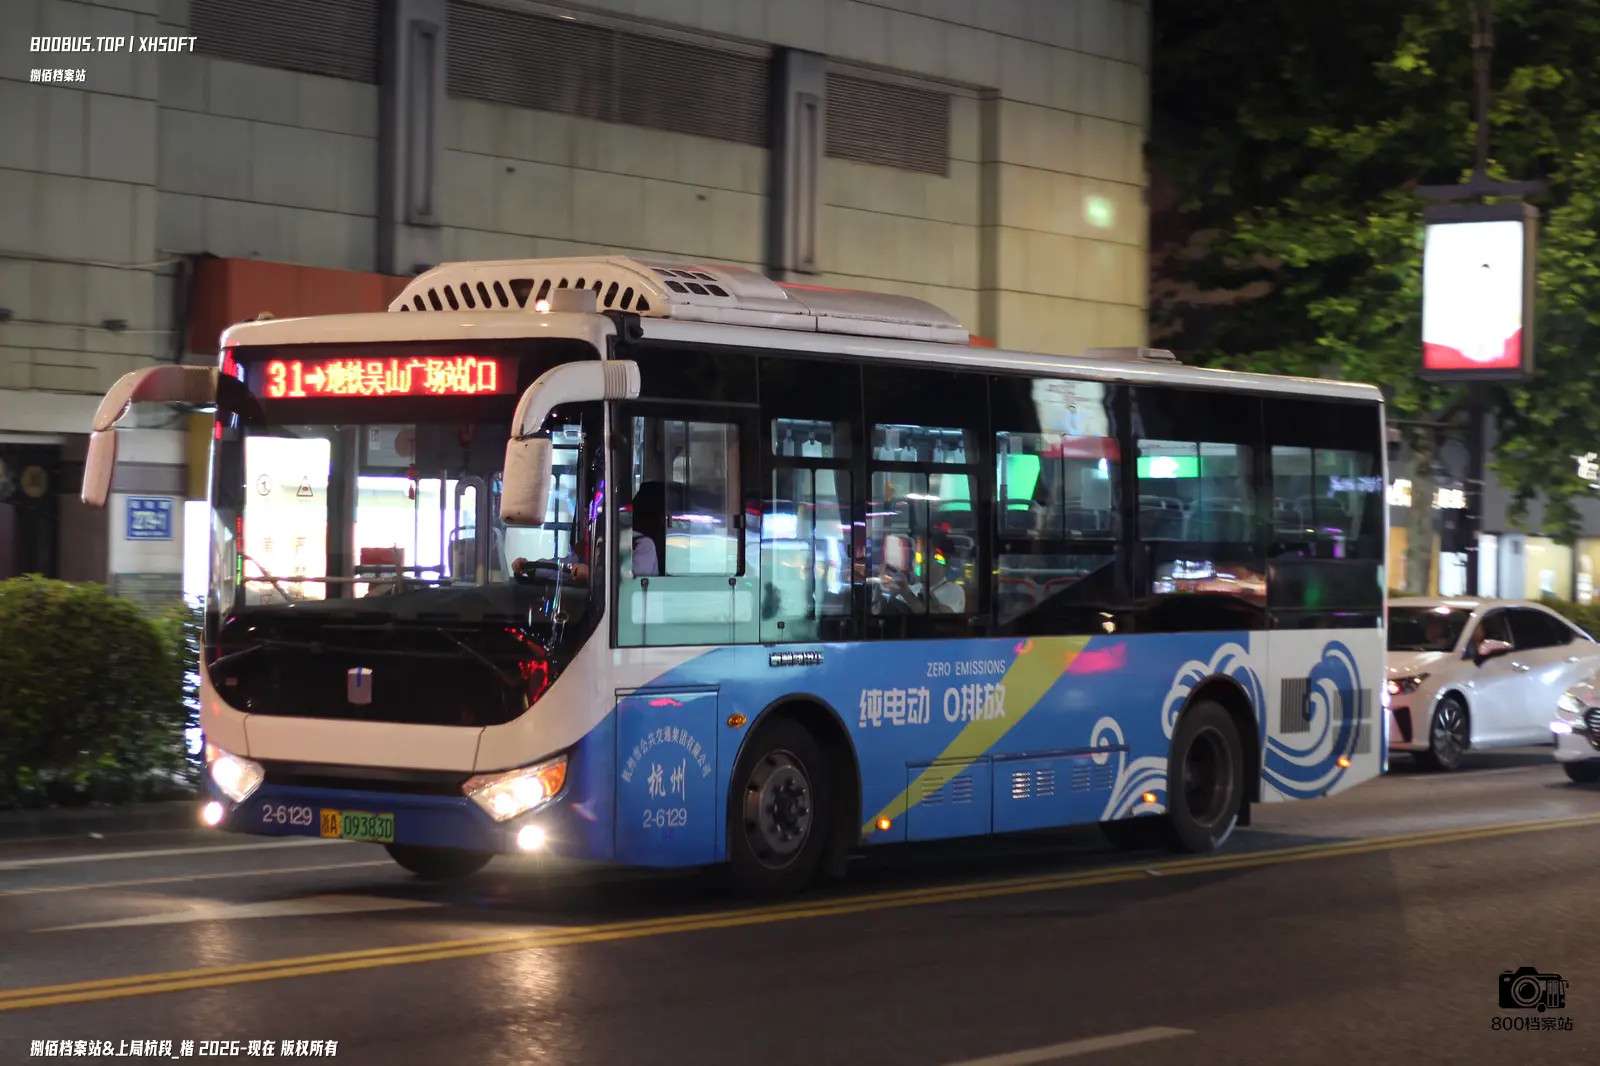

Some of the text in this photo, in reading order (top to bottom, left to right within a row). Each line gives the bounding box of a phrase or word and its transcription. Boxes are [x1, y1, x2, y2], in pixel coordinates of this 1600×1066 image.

[268, 362, 306, 397] 31
[927, 659, 1006, 677] ZERO EMISSIONS
[859, 686, 930, 728] 纯电动
[647, 757, 686, 802] 杭州
[262, 804, 313, 826] 2-6129
[643, 808, 688, 828] 2-6129
